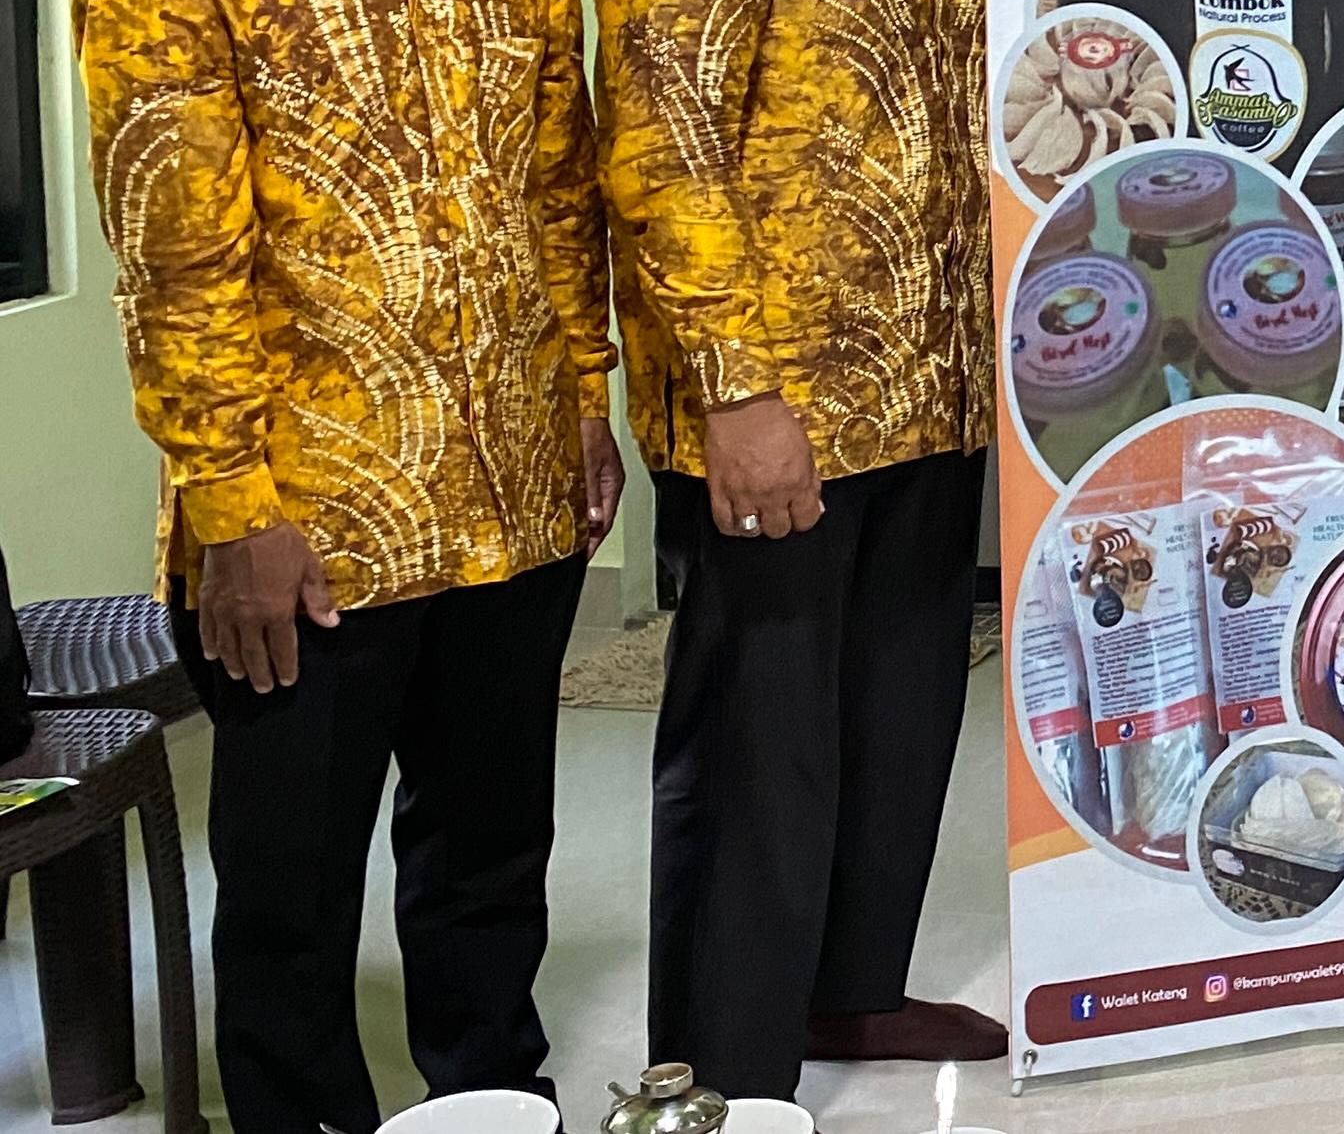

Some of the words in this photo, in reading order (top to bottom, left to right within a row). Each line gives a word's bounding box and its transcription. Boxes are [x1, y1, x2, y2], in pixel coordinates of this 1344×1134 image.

[1199, 8, 1239, 23] Natural
[1241, 11, 1287, 23] Process
[1101, 991, 1139, 1010] Walet
[1142, 986, 1188, 1004] Kateng
